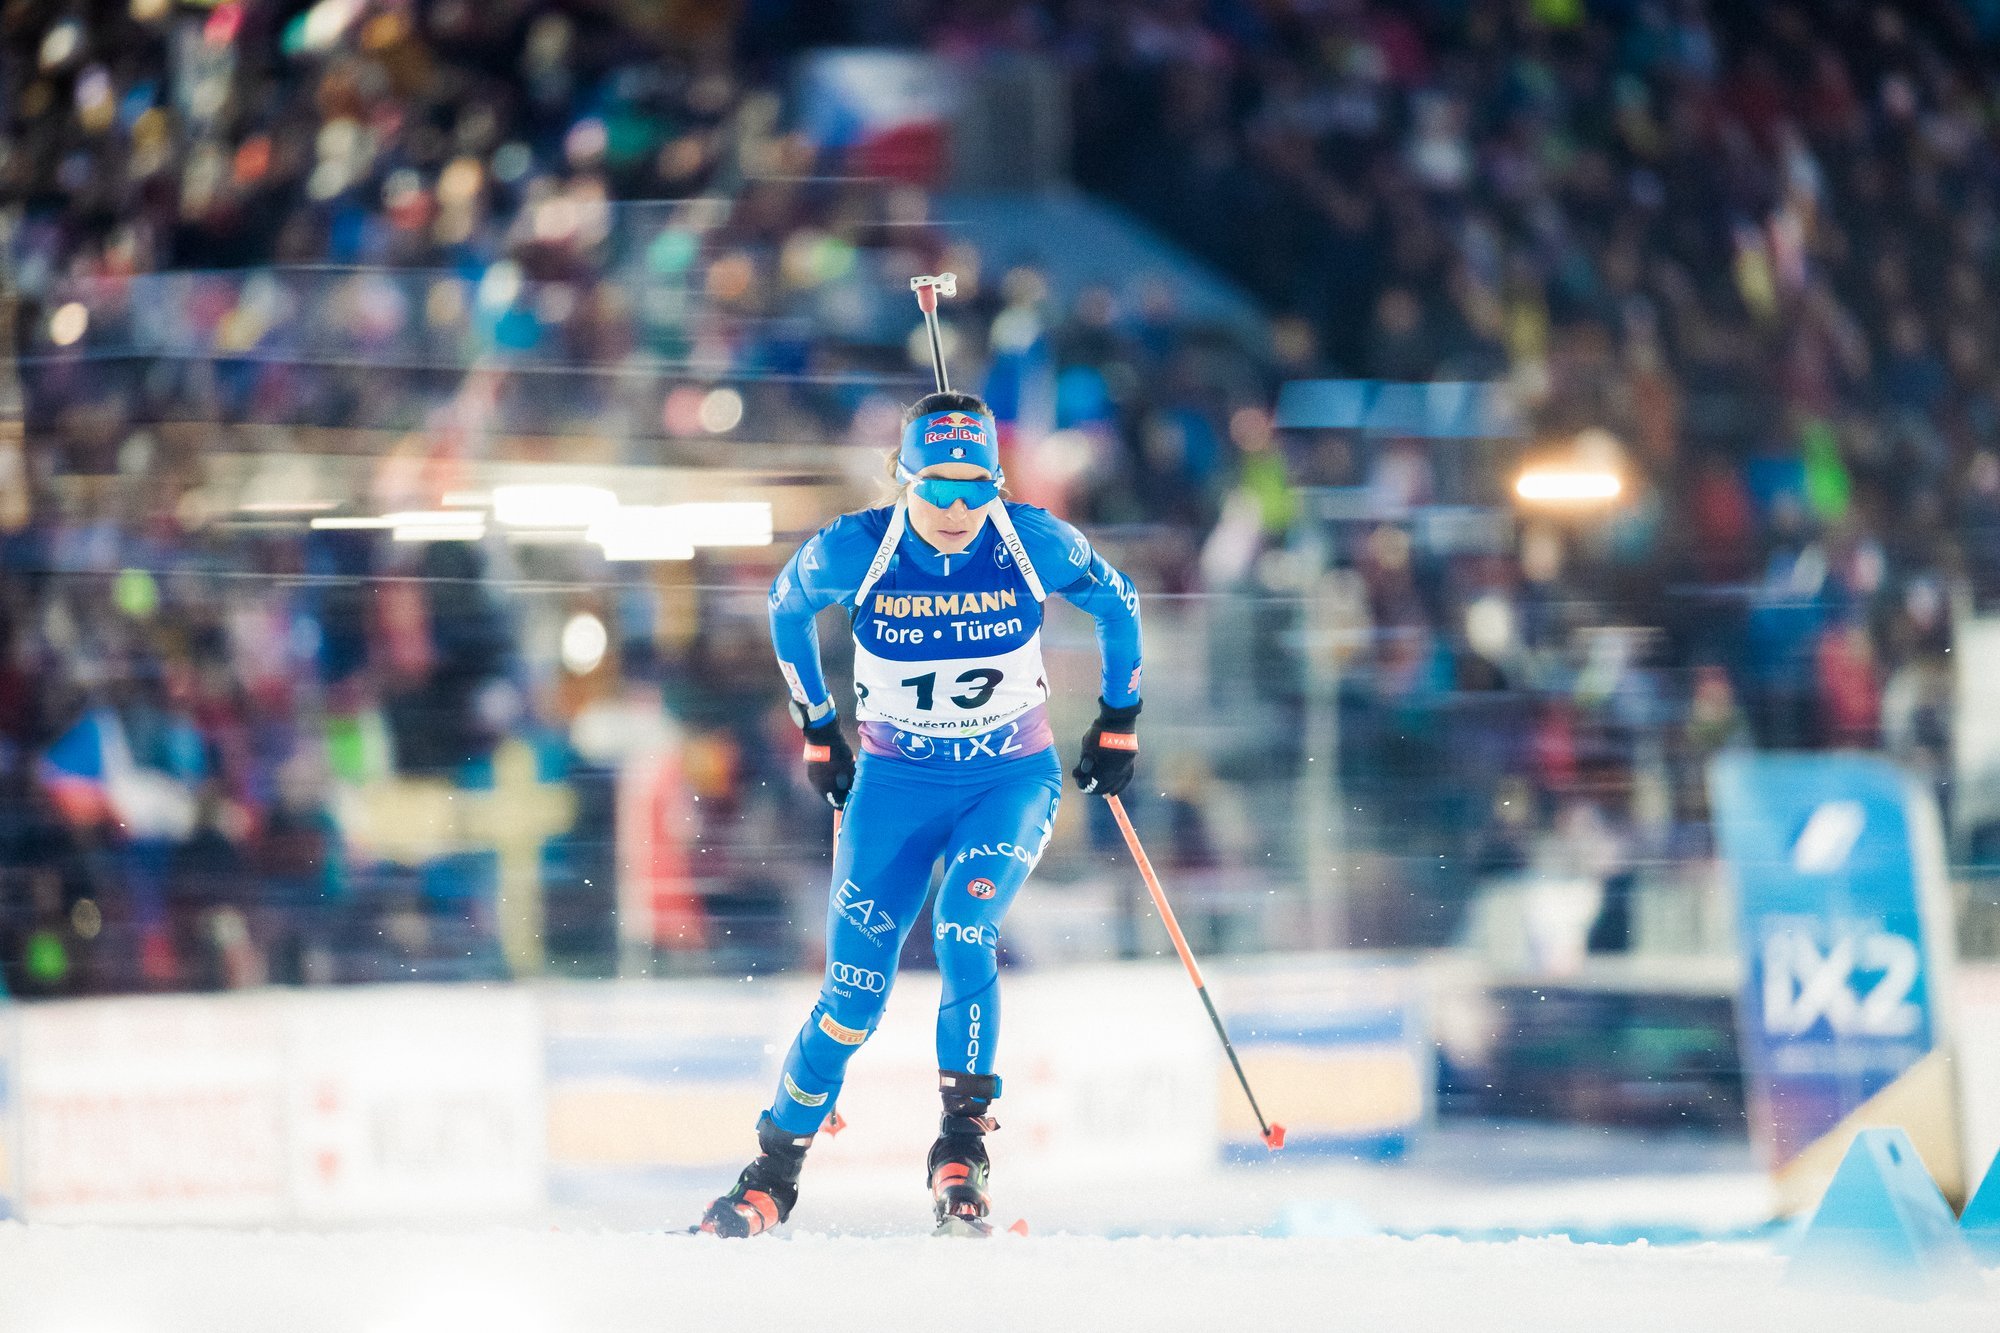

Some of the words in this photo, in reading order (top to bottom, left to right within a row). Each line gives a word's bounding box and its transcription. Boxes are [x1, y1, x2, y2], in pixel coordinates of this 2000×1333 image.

[925, 428, 957, 445] Red
[958, 428, 987, 447] Bull
[868, 536, 896, 580] FIOCCHI
[1005, 532, 1033, 577] FIOCCHI
[873, 619, 924, 645] Tore
[951, 617, 1022, 642] Türen
[901, 667, 1004, 711] 13
[961, 718, 978, 729] NA
[835, 878, 897, 935] EA7
[935, 921, 984, 946] enel
[832, 985, 852, 999] Audi
